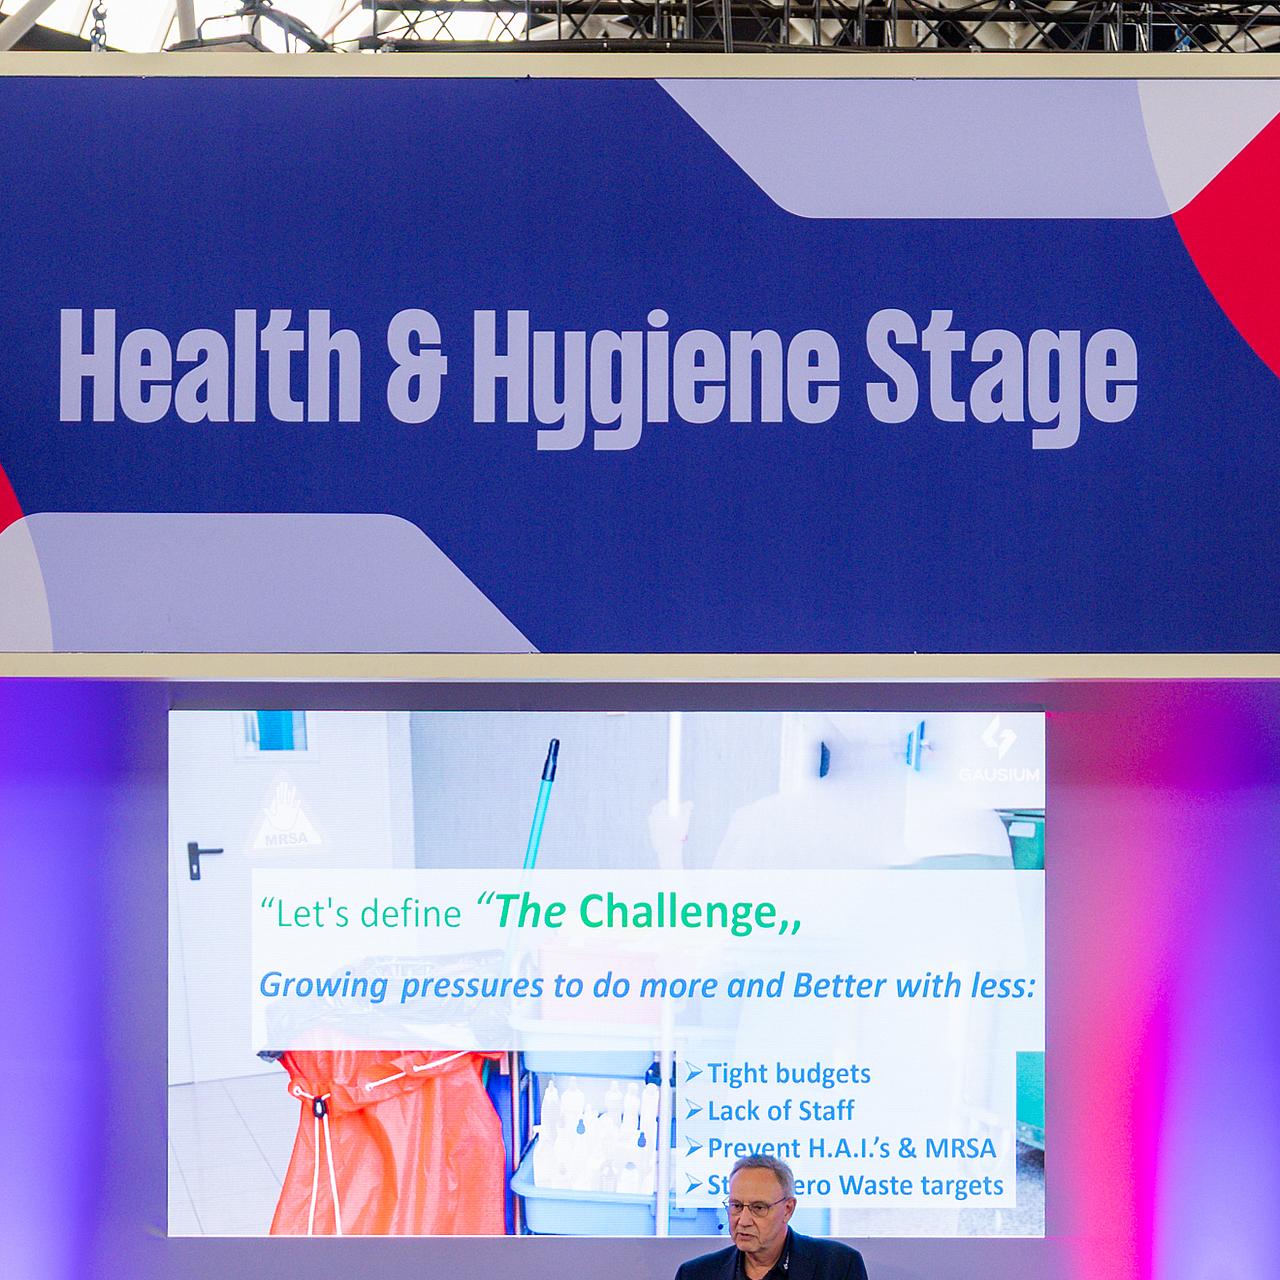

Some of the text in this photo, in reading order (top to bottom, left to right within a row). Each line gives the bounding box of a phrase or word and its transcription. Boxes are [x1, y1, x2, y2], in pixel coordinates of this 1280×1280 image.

[59, 308, 1138, 451] Health & Hygiene Stage
[360, 897, 461, 928] define
[259, 970, 1036, 1005] Growing pressures to do more and Better with less:
[707, 1061, 871, 1089] Tight budgets
[708, 1098, 855, 1121] Lack of Staff
[708, 1137, 801, 1158] Prevent
[898, 1137, 917, 1159] &
[925, 1137, 997, 1159] MRSA
[794, 1177, 831, 1195] ero
[839, 1174, 913, 1196] Waste
[920, 1175, 1004, 1201] targets
